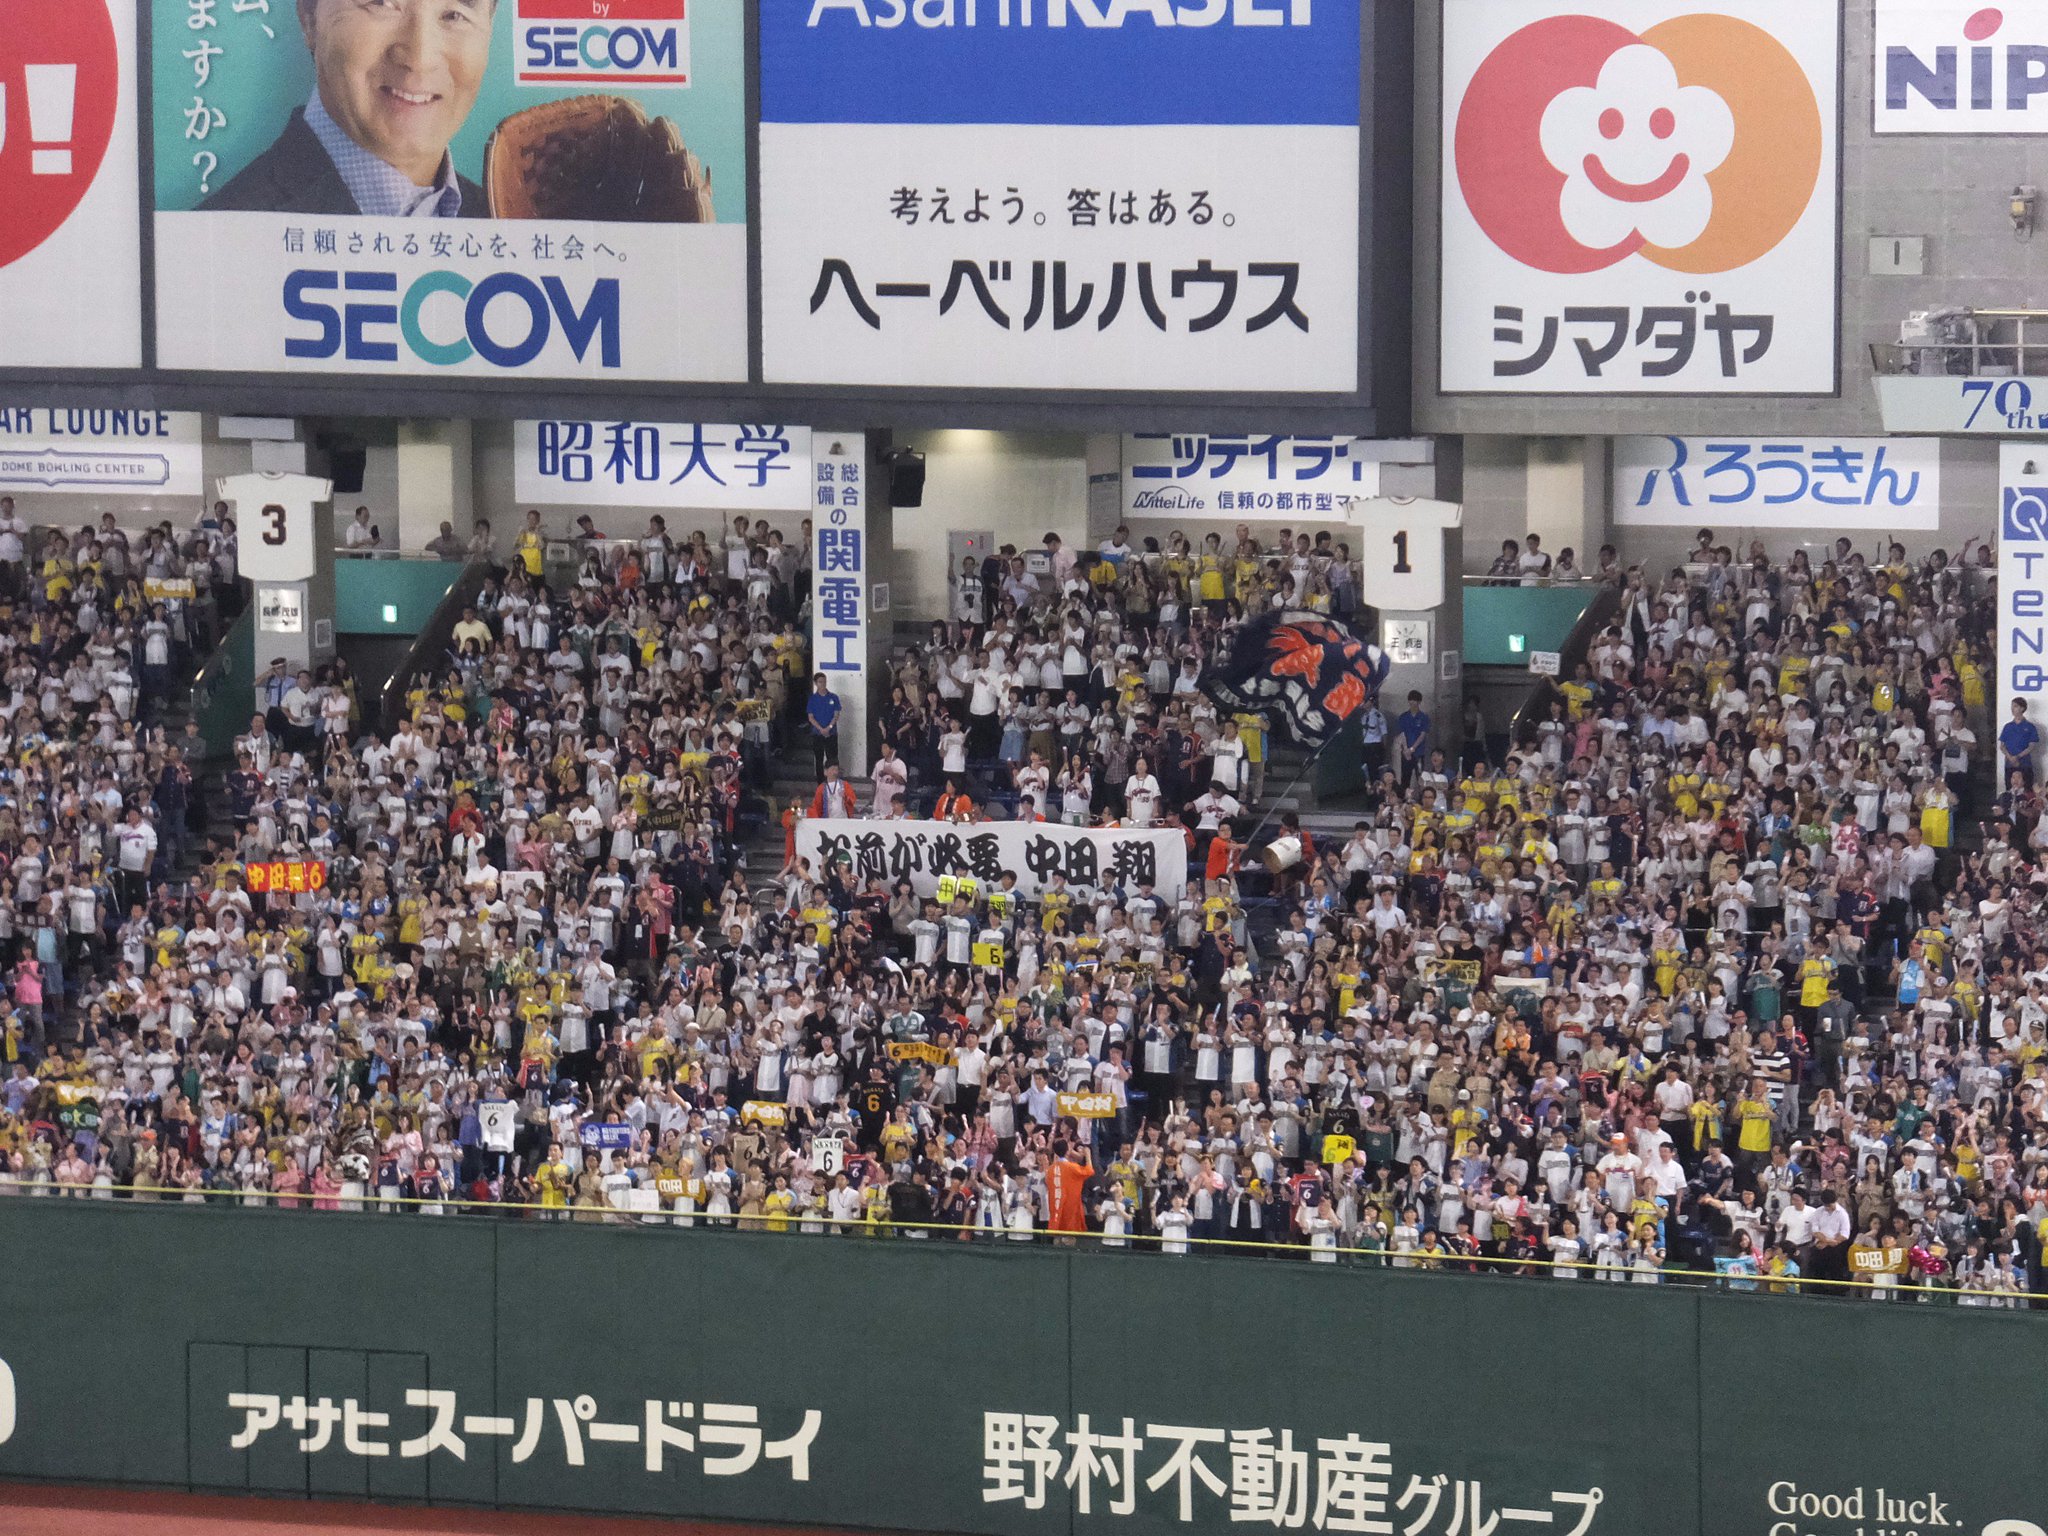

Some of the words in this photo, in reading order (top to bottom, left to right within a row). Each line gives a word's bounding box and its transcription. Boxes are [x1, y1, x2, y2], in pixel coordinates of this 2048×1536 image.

[593, 2, 609, 17] by
[525, 25, 678, 70] SECOM
[890, 186, 1235, 227] 考えよう。答はある。
[283, 226, 629, 262] 信頼される安心を、社会へ。
[810, 258, 1309, 333] ヘーベルハウス
[283, 269, 622, 369] SECOM
[1493, 290, 1774, 377] シマダヤ
[49, 408, 169, 437] LOUNGE
[2, 461, 33, 472] DOME
[38, 462, 91, 474] BOWLING
[95, 463, 145, 475] CENTER
[537, 421, 791, 487] 昭和大学
[1703, 443, 1920, 507] ろうきん
[261, 504, 287, 546] 3
[1392, 530, 1412, 574] 1
[818, 528, 862, 672] 関電工
[990, 948, 1000, 965] 6
[487, 1112, 499, 1127] 6
[867, 1094, 881, 1112] 6
[1333, 1119, 1344, 1134] 6
[823, 1151, 833, 1173] 6
[852, 1167, 860, 1178] 6
[1303, 1189, 1311, 1200] 6
[228, 1388, 822, 1481] アサヒスーパードライ
[982, 1411, 1604, 1536] 野村不動産グループ
[1767, 1481, 1865, 1520] Good
[1876, 1488, 1963, 1528] luck.
